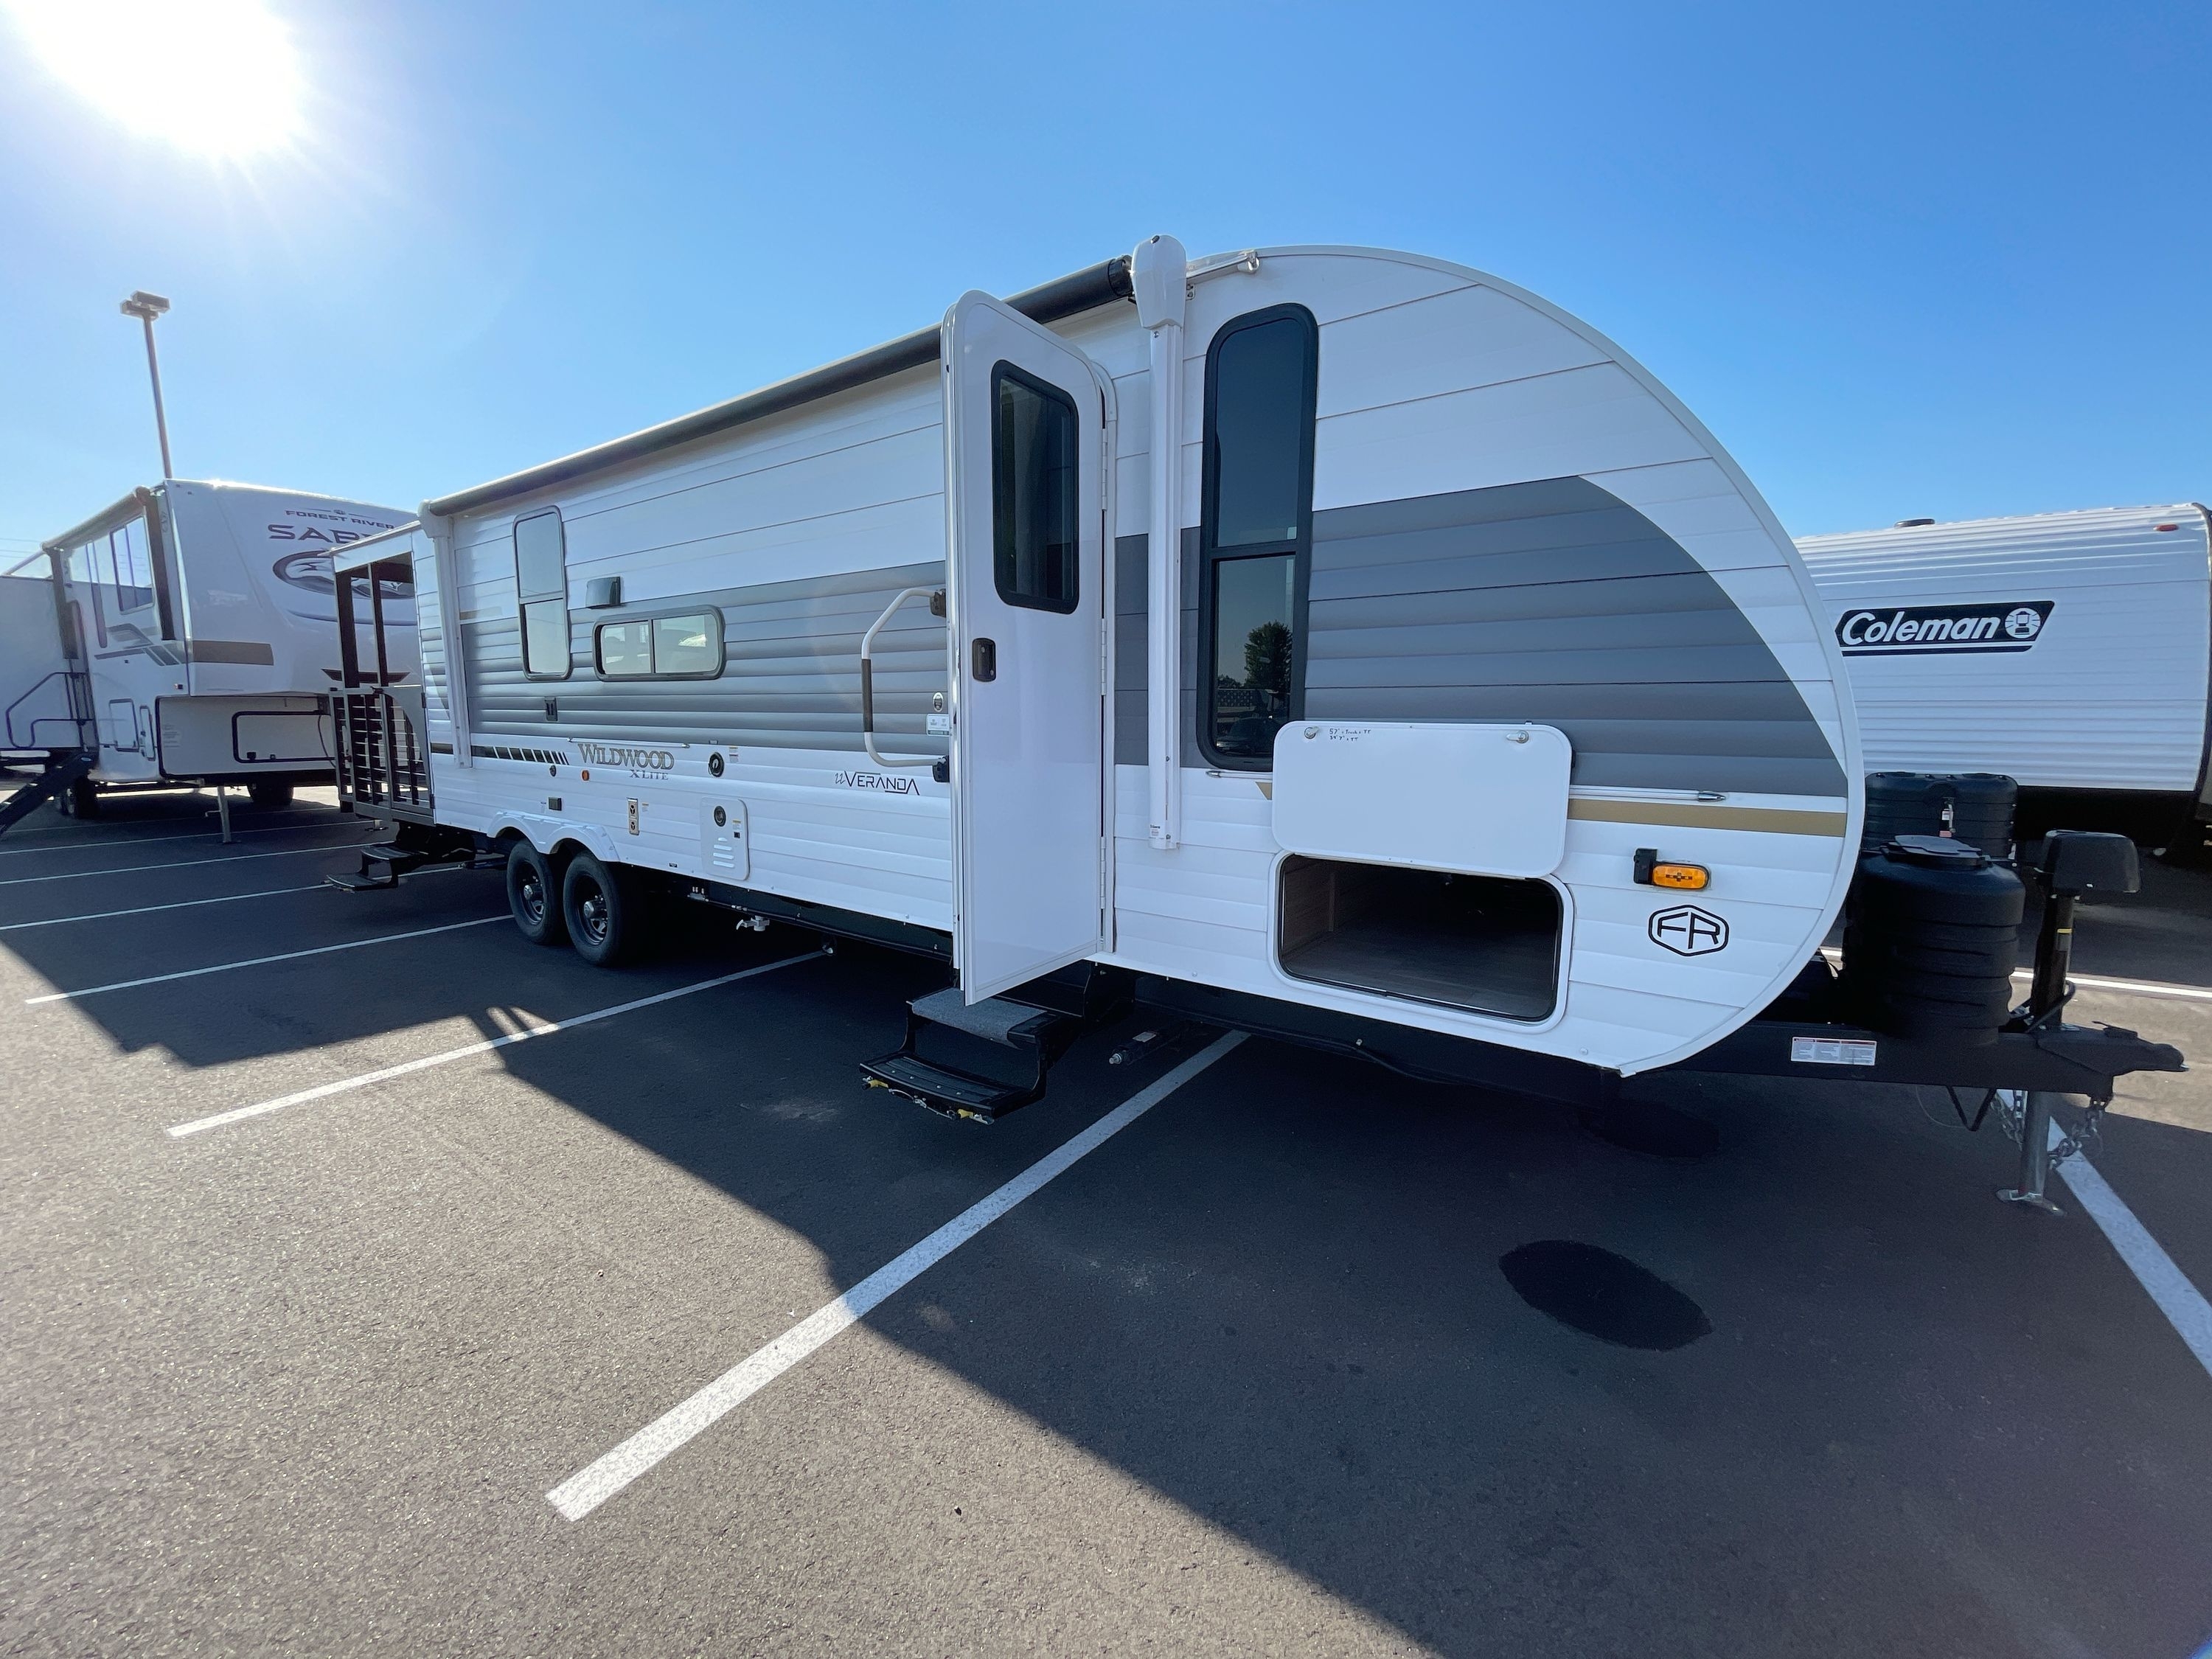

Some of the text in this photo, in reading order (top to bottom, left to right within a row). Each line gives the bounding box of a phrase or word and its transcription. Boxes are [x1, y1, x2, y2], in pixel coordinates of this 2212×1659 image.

[285, 509, 394, 529] FOREST RIVER
[268, 524, 372, 544] SAB
[1842, 611, 2001, 646] Coleman
[577, 743, 675, 771] WILDWOOD
[1657, 911, 1720, 950] FR
